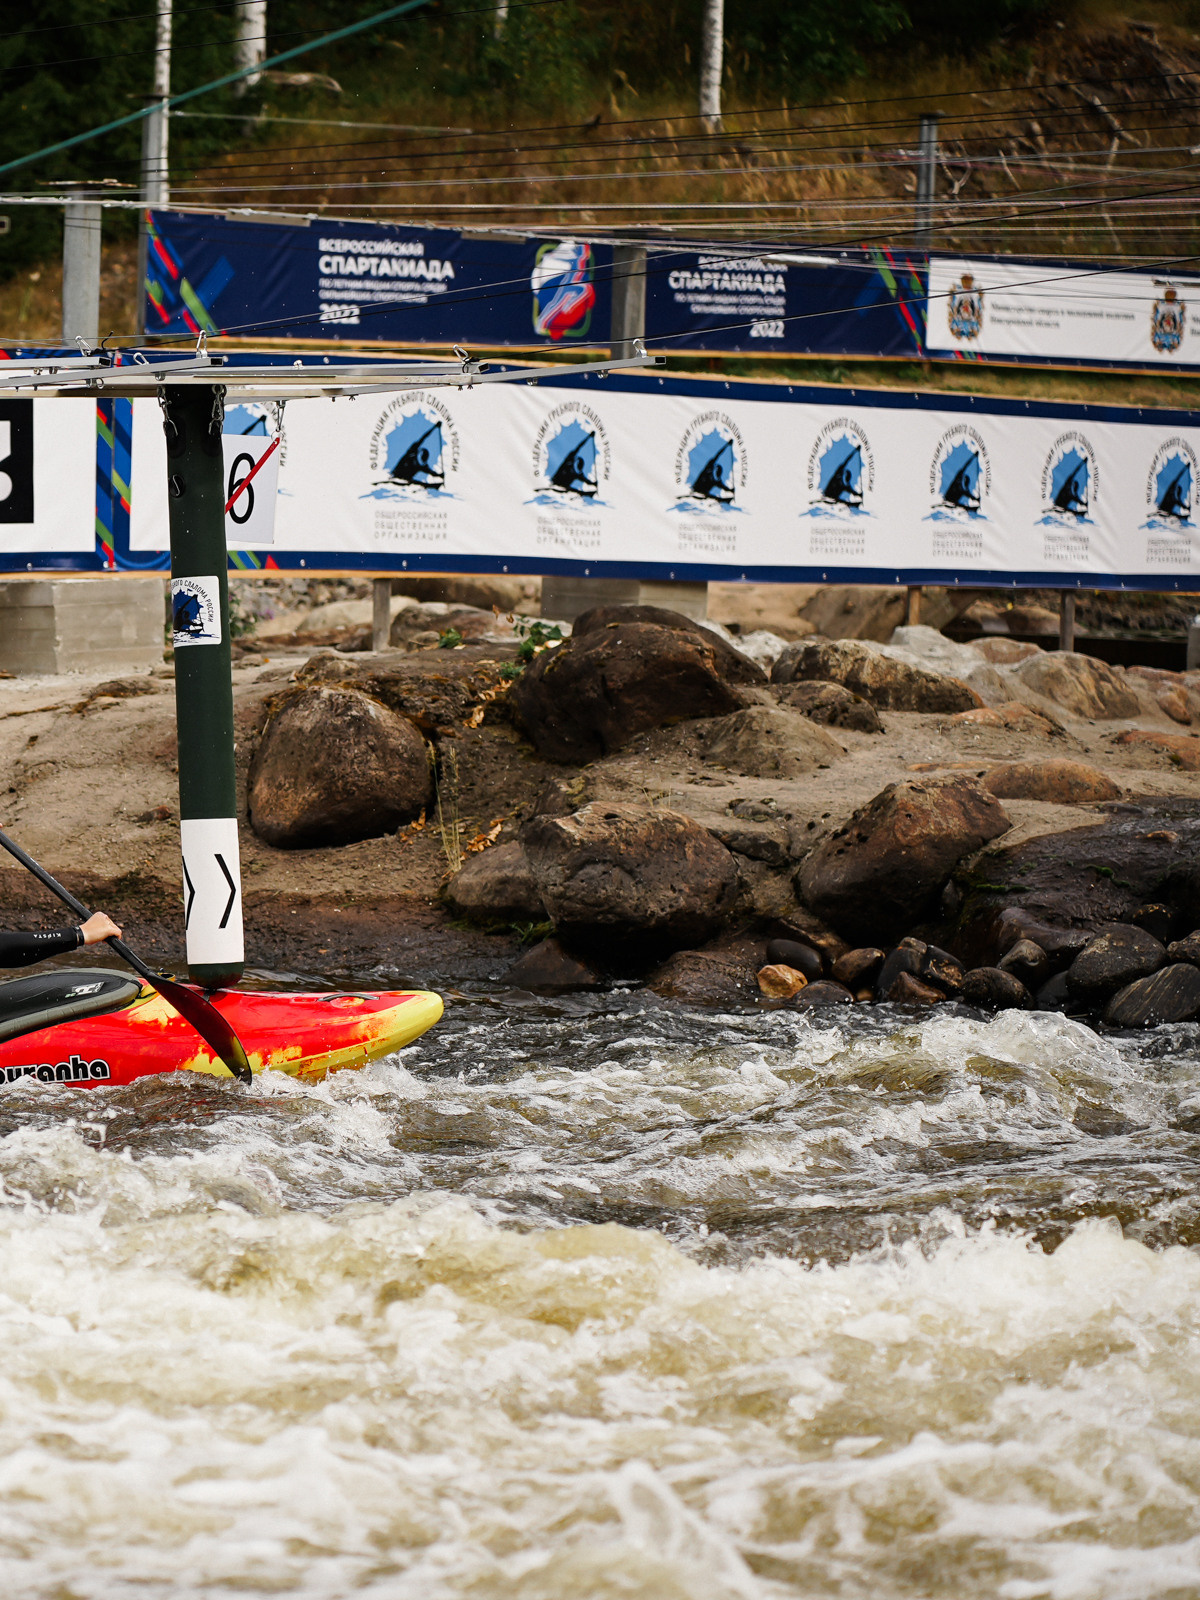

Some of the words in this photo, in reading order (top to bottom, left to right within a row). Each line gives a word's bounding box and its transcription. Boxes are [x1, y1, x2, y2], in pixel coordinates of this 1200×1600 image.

[318, 238, 424, 256] ВСЕРОССИЙСКАЯ
[318, 255, 455, 281] СПАРТАКИАДА
[668, 271, 786, 294] СПАРТАКИАДА
[319, 303, 360, 324] 2022
[749, 318, 785, 337] 2022
[228, 452, 255, 524] 6
[184, 580, 208, 599] СЛАЛОМА
[205, 599, 214, 623] РОССИИ
